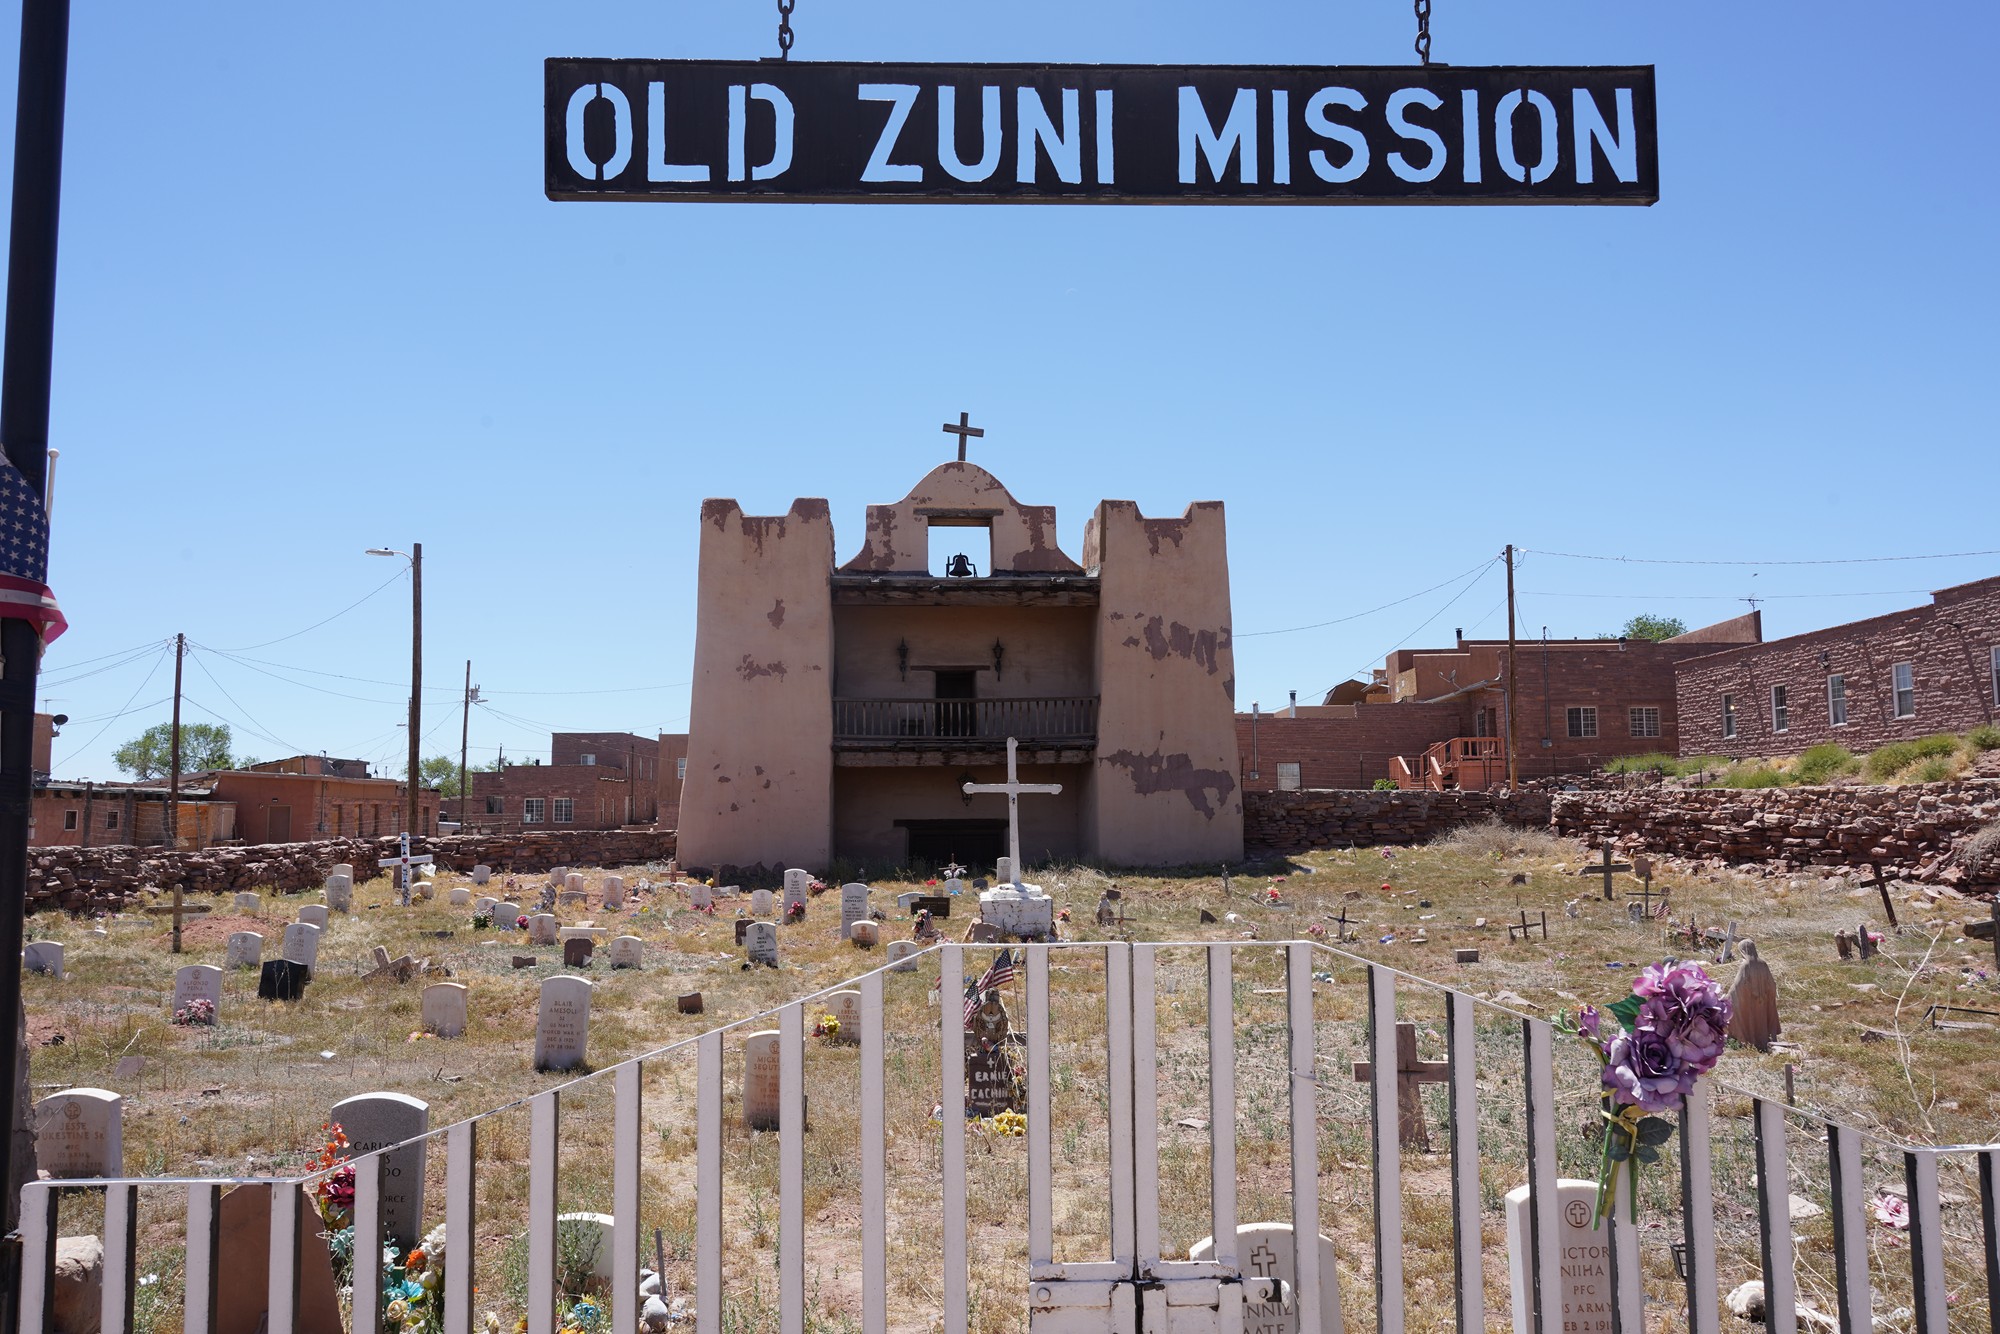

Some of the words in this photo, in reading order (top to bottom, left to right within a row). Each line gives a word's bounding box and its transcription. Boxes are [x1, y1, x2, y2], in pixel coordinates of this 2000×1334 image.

[565, 81, 795, 182] OLD
[857, 83, 1115, 184] ZUNI
[1178, 86, 1639, 185] MISSION
[975, 1072, 1008, 1082] ERNIE
[60, 1122, 88, 1130] JESSE
[42, 1132, 90, 1140] UKESTINE
[1562, 1246, 1610, 1259] ICTOR
[1560, 1265, 1604, 1277] NIIHA
[1574, 1285, 1596, 1295] PFC
[1577, 1303, 1612, 1313] ARMY
[1564, 1322, 1578, 1332] EB
[1584, 1321, 1590, 1330] 2
[1596, 1320, 1612, 1330] 191
